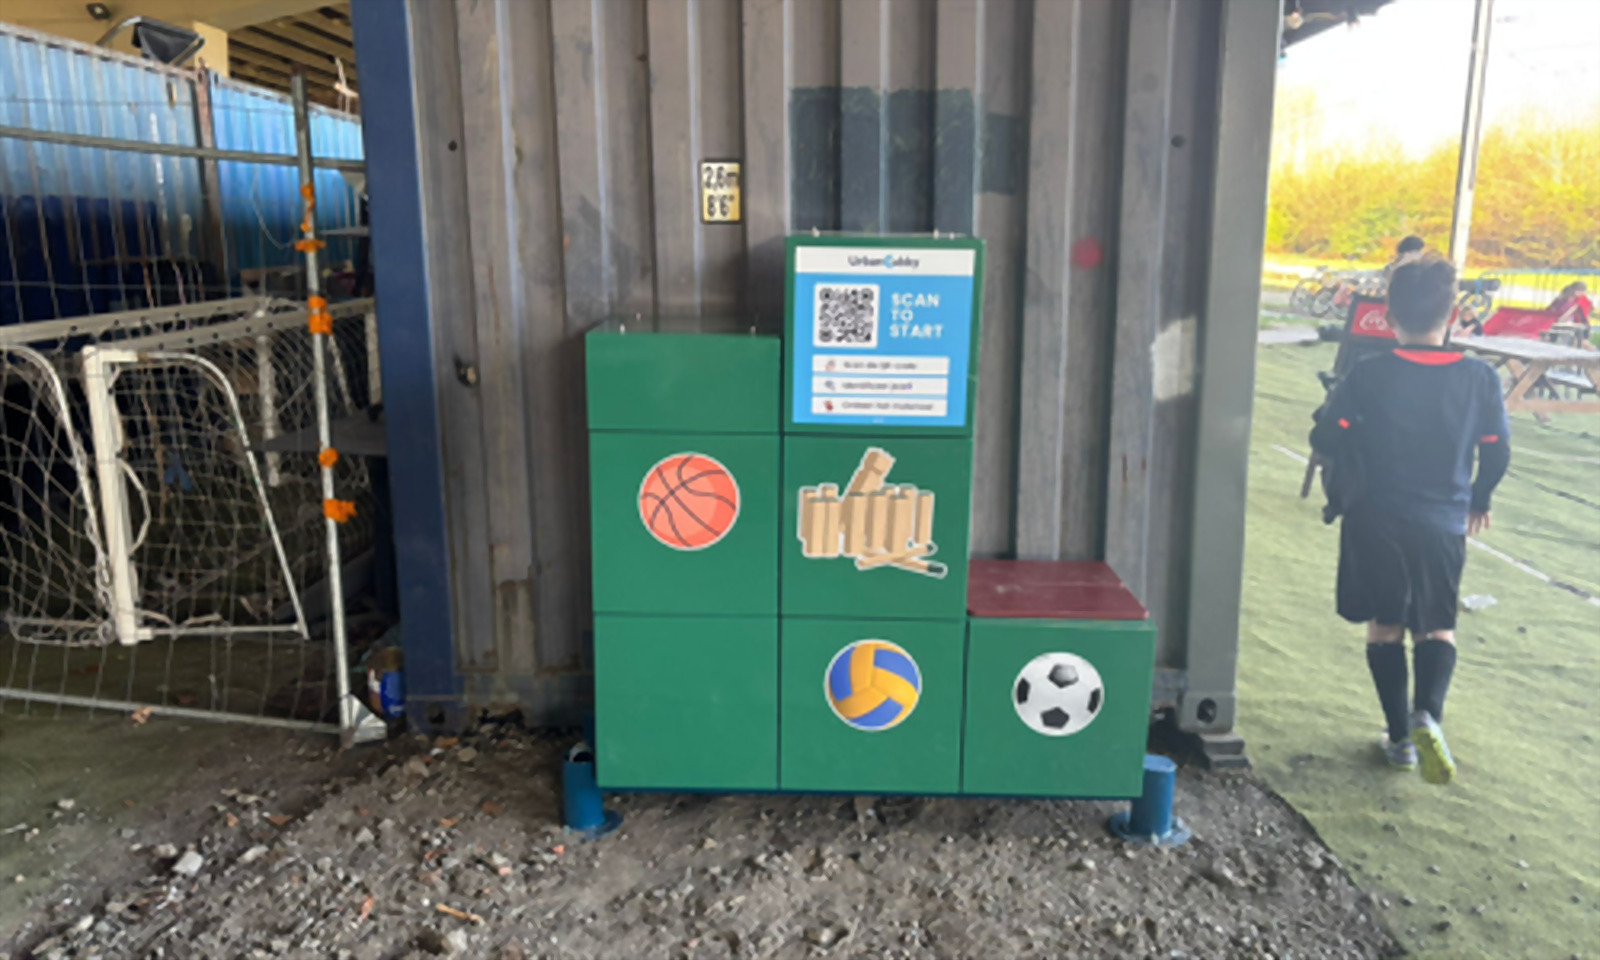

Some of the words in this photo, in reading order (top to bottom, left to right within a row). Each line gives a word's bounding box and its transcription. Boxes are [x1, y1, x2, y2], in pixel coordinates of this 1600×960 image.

[891, 293, 940, 308] SCAN
[891, 309, 914, 322] TO
[889, 324, 944, 339] START
